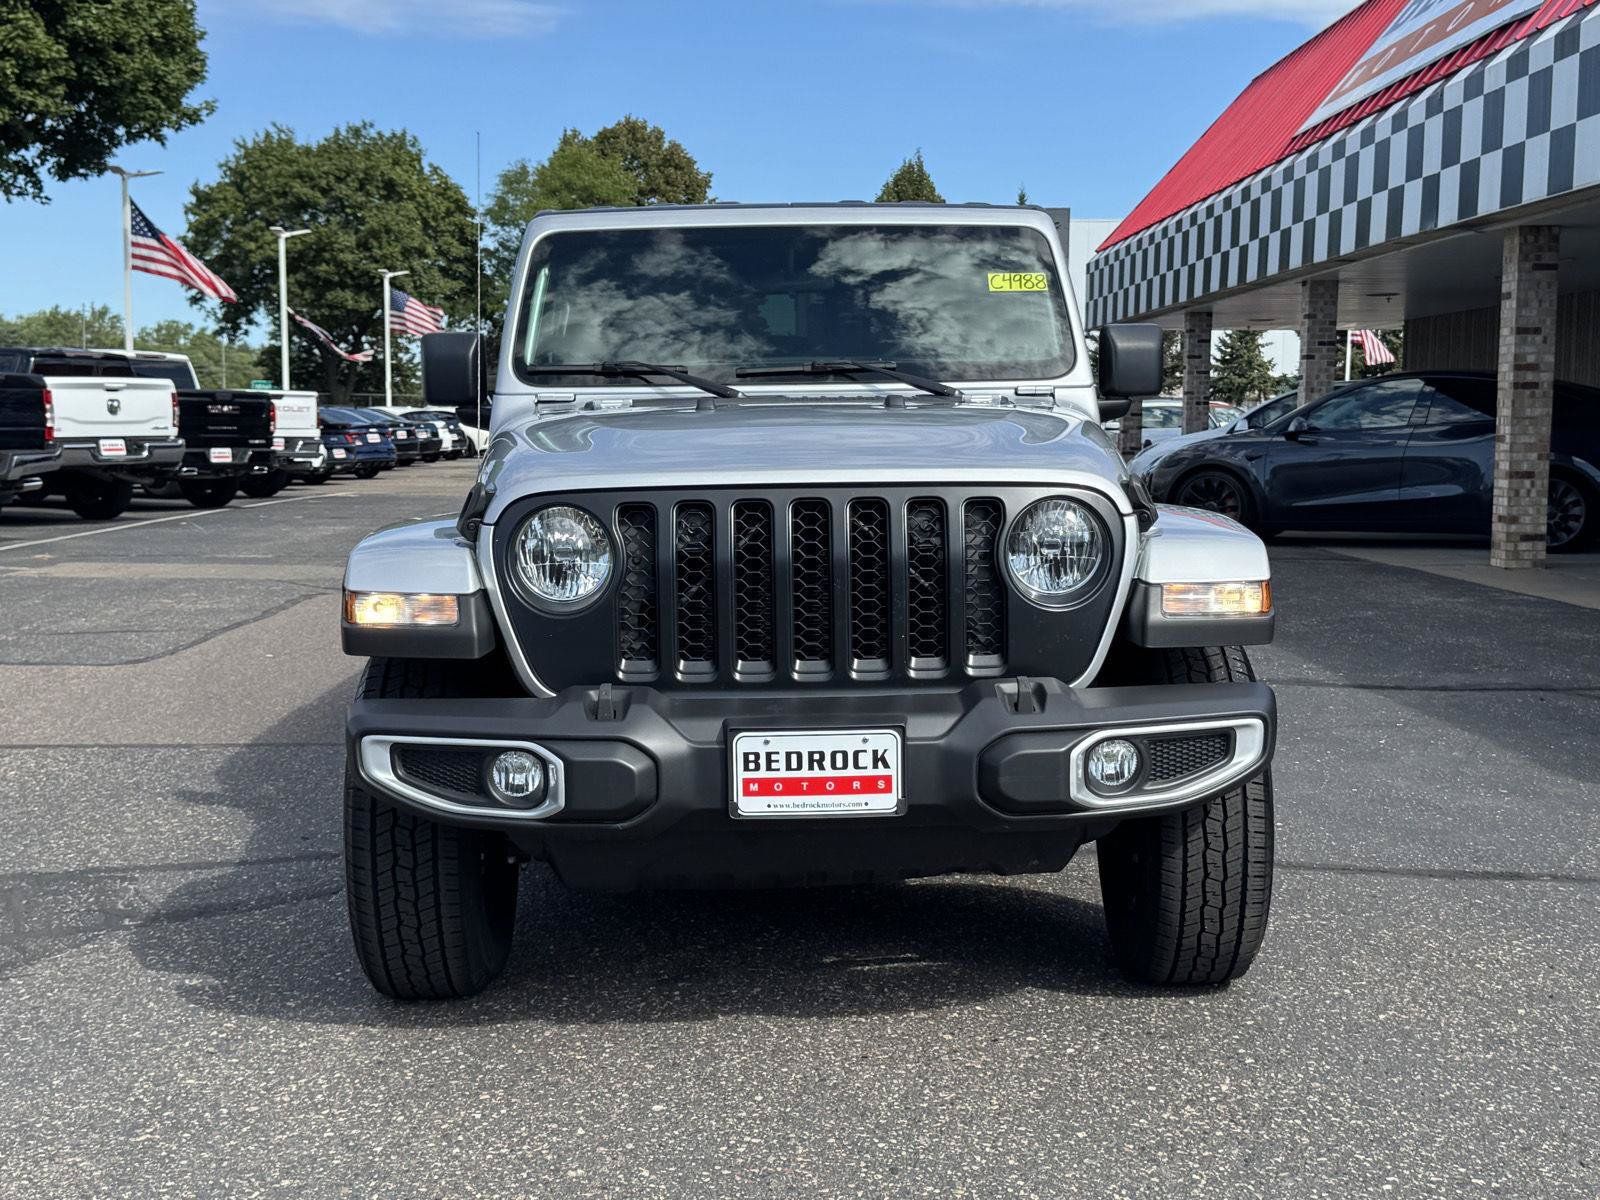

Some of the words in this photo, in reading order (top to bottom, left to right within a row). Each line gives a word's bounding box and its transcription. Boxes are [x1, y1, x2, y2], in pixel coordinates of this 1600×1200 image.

[1340, 0, 1503, 92] MOTO
[991, 273, 1047, 290] C4988
[742, 749, 891, 772] BEDROCK
[749, 779, 886, 792] MOTORS
[773, 801, 863, 809] www.bedrockmotors.com
